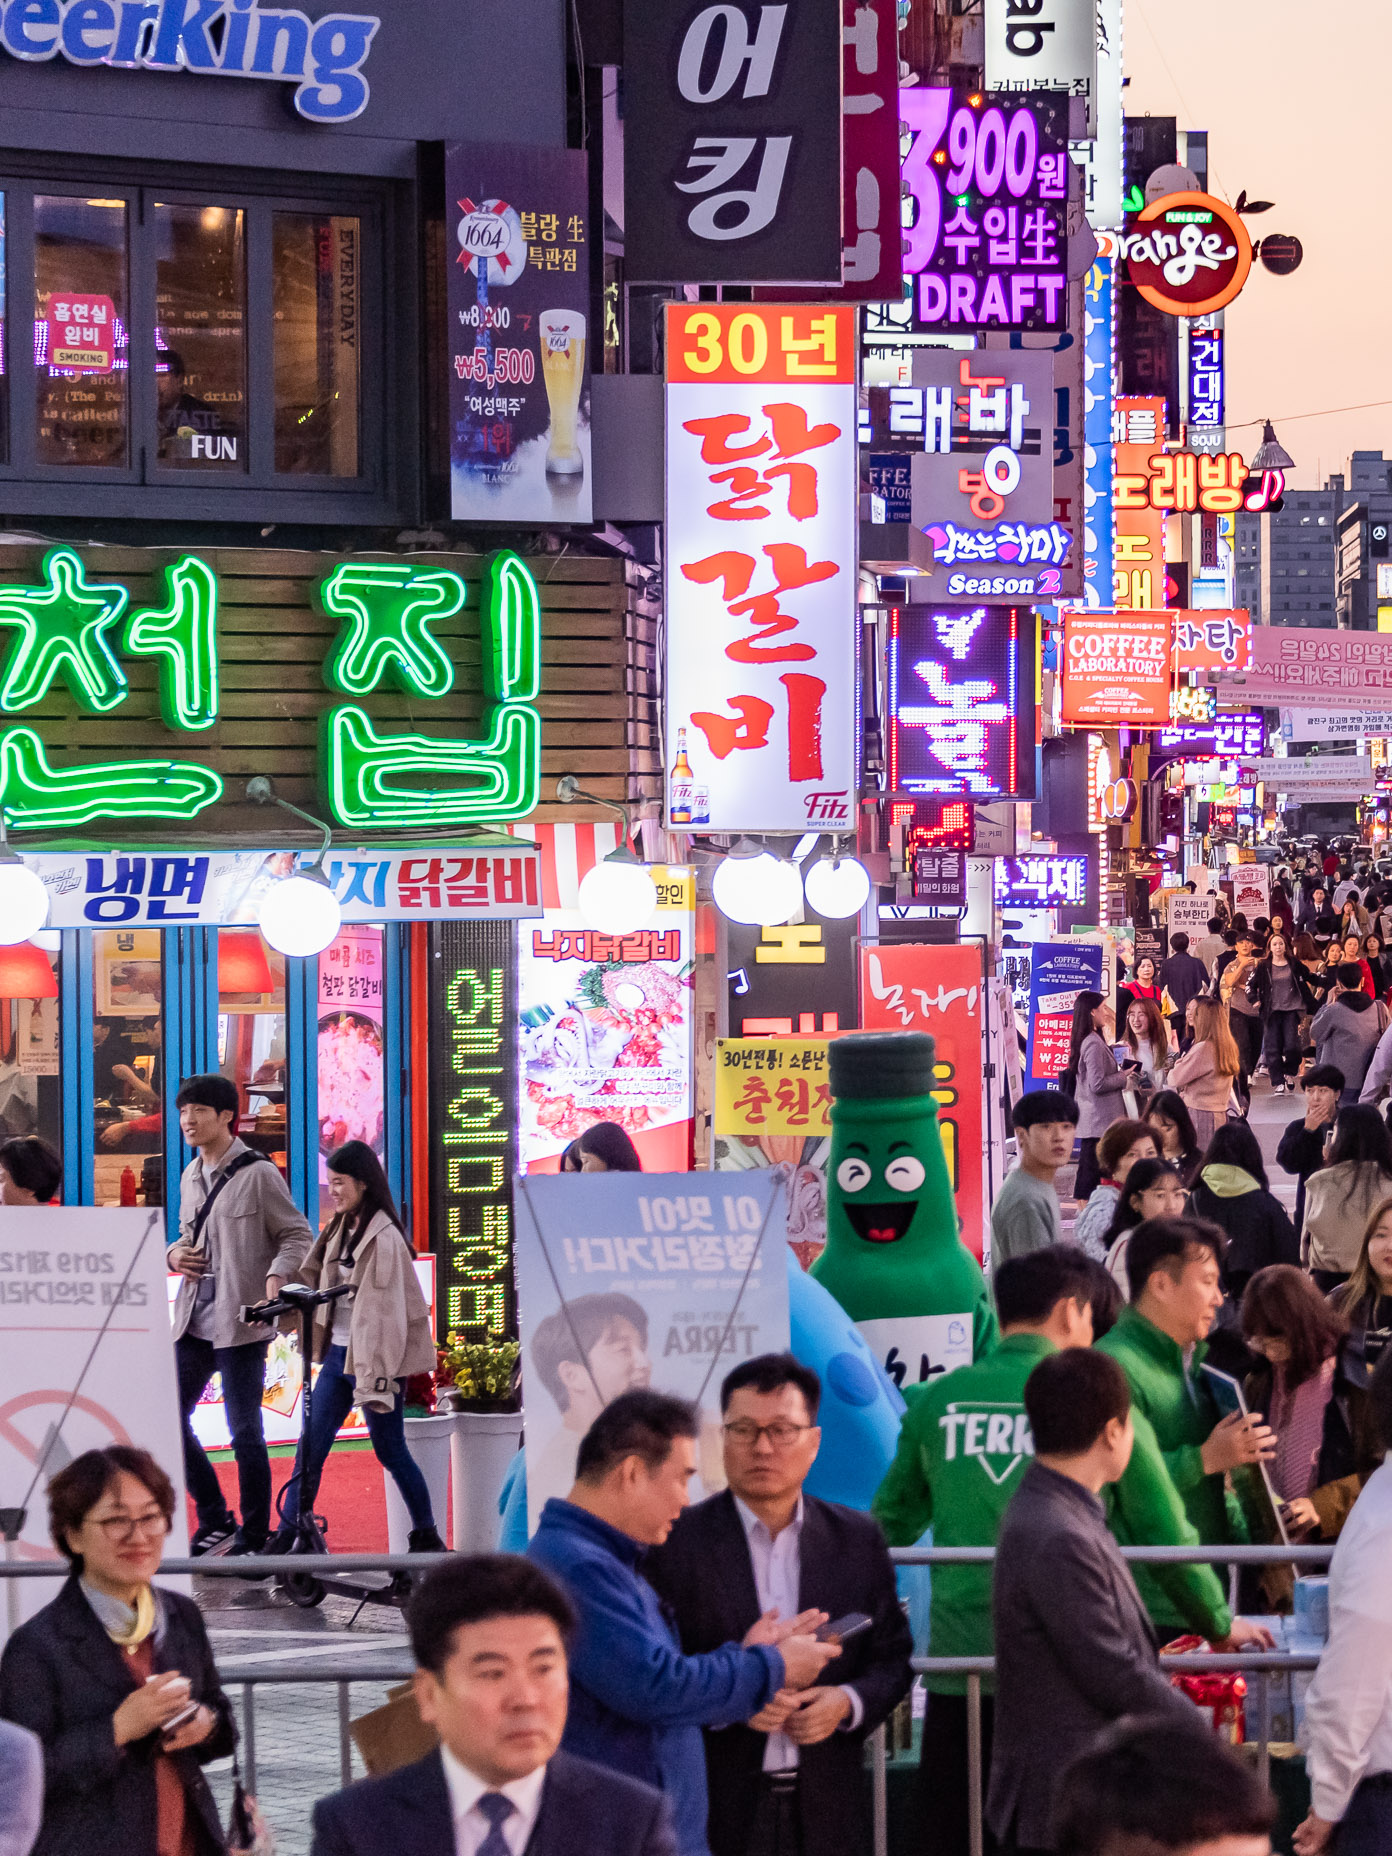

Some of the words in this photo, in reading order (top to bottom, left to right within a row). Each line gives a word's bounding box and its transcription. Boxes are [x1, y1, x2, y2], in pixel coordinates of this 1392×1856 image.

[464, 221, 504, 249] 1664
[520, 211, 559, 242] 블랑
[566, 215, 585, 243] 生
[527, 246, 577, 272] 특판점
[340, 228, 356, 349] EVERYDAY
[918, 273, 1065, 324] DRAFT
[59, 352, 104, 364] SMOKING
[683, 312, 838, 376] 30년
[191, 434, 237, 461] FUN
[1191, 435, 1221, 447] SOJU
[680, 402, 842, 783] 닭갈비
[946, 571, 1035, 595] Season
[1036, 567, 1063, 595] 2
[1068, 634, 1167, 660] COFFEE
[1068, 657, 1167, 677] LABORATORY
[803, 789, 849, 820] Fitz
[84, 856, 210, 923] 냉면
[396, 856, 539, 909] 닭갈비
[1174, 910, 1210, 920] 승부한다
[532, 929, 681, 962] 낙지닭갈비
[1053, 956, 1081, 965] COFFEE
